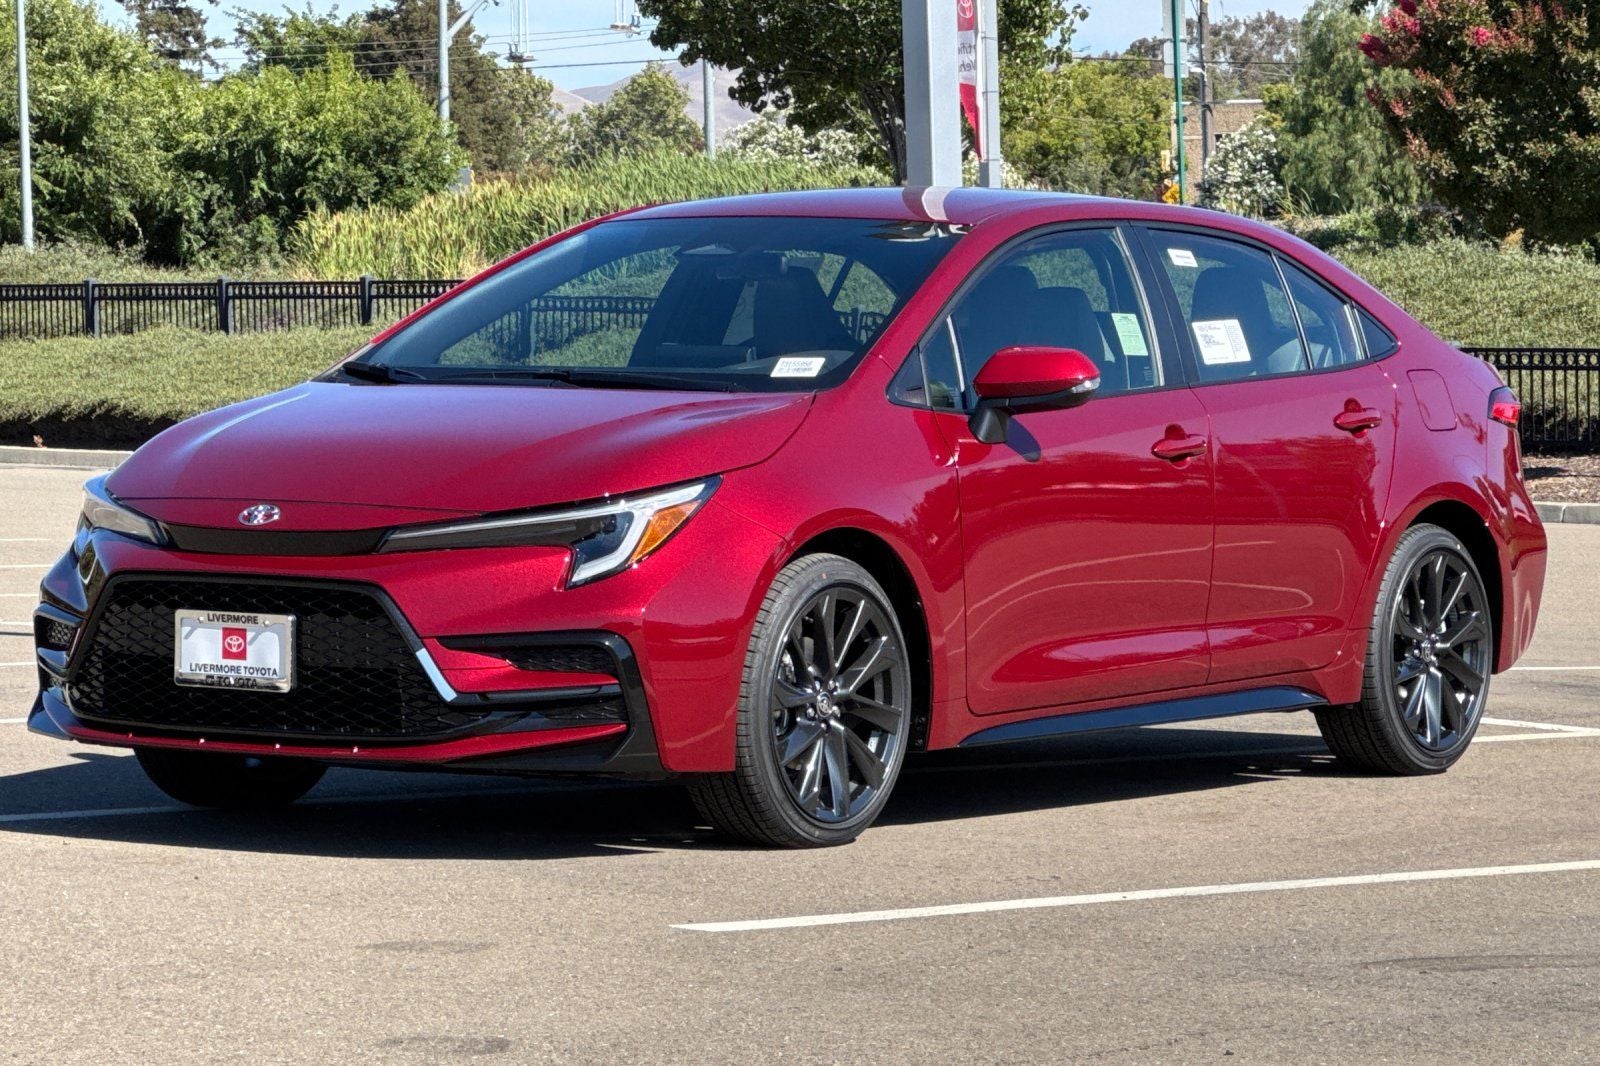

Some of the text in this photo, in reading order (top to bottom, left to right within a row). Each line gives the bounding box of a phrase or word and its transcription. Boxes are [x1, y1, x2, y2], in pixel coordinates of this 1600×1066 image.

[207, 613, 259, 624] LIVERMORE
[189, 663, 278, 677] LIVERMORE TOYOTA
